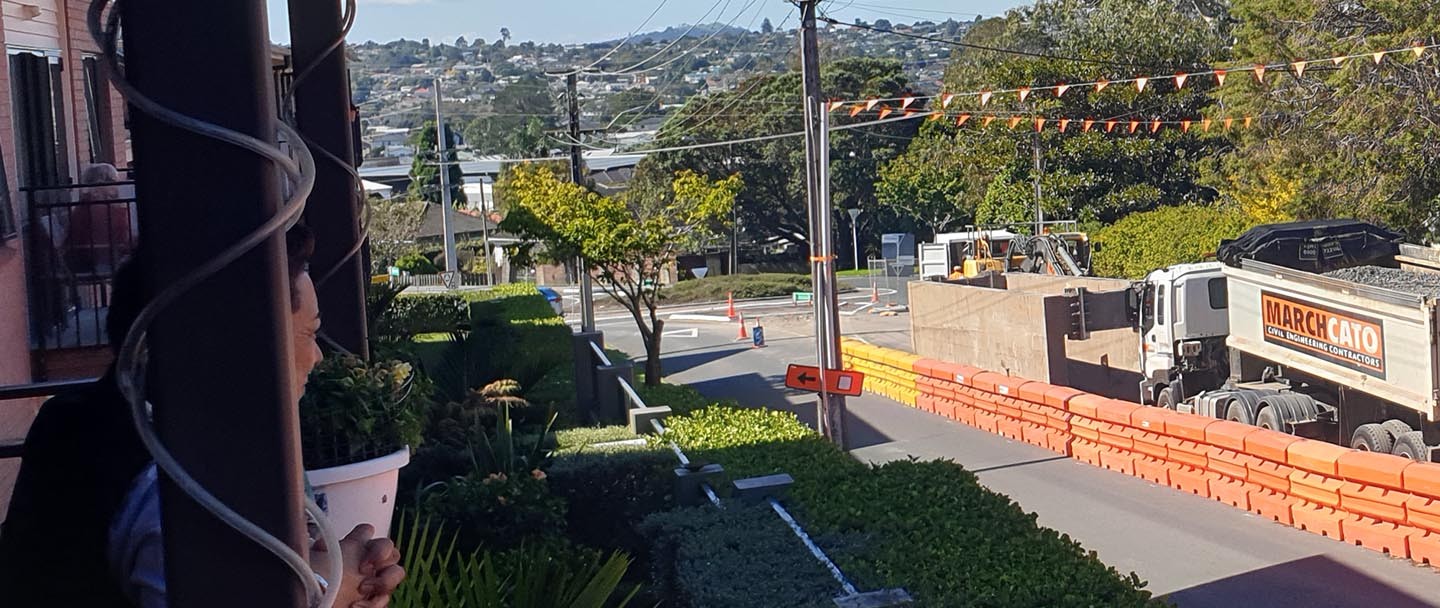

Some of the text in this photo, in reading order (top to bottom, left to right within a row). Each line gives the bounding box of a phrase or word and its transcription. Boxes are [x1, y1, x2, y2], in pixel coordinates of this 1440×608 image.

[1267, 326, 1381, 368] CIVIL ENGINEERING CONTRACTORS
